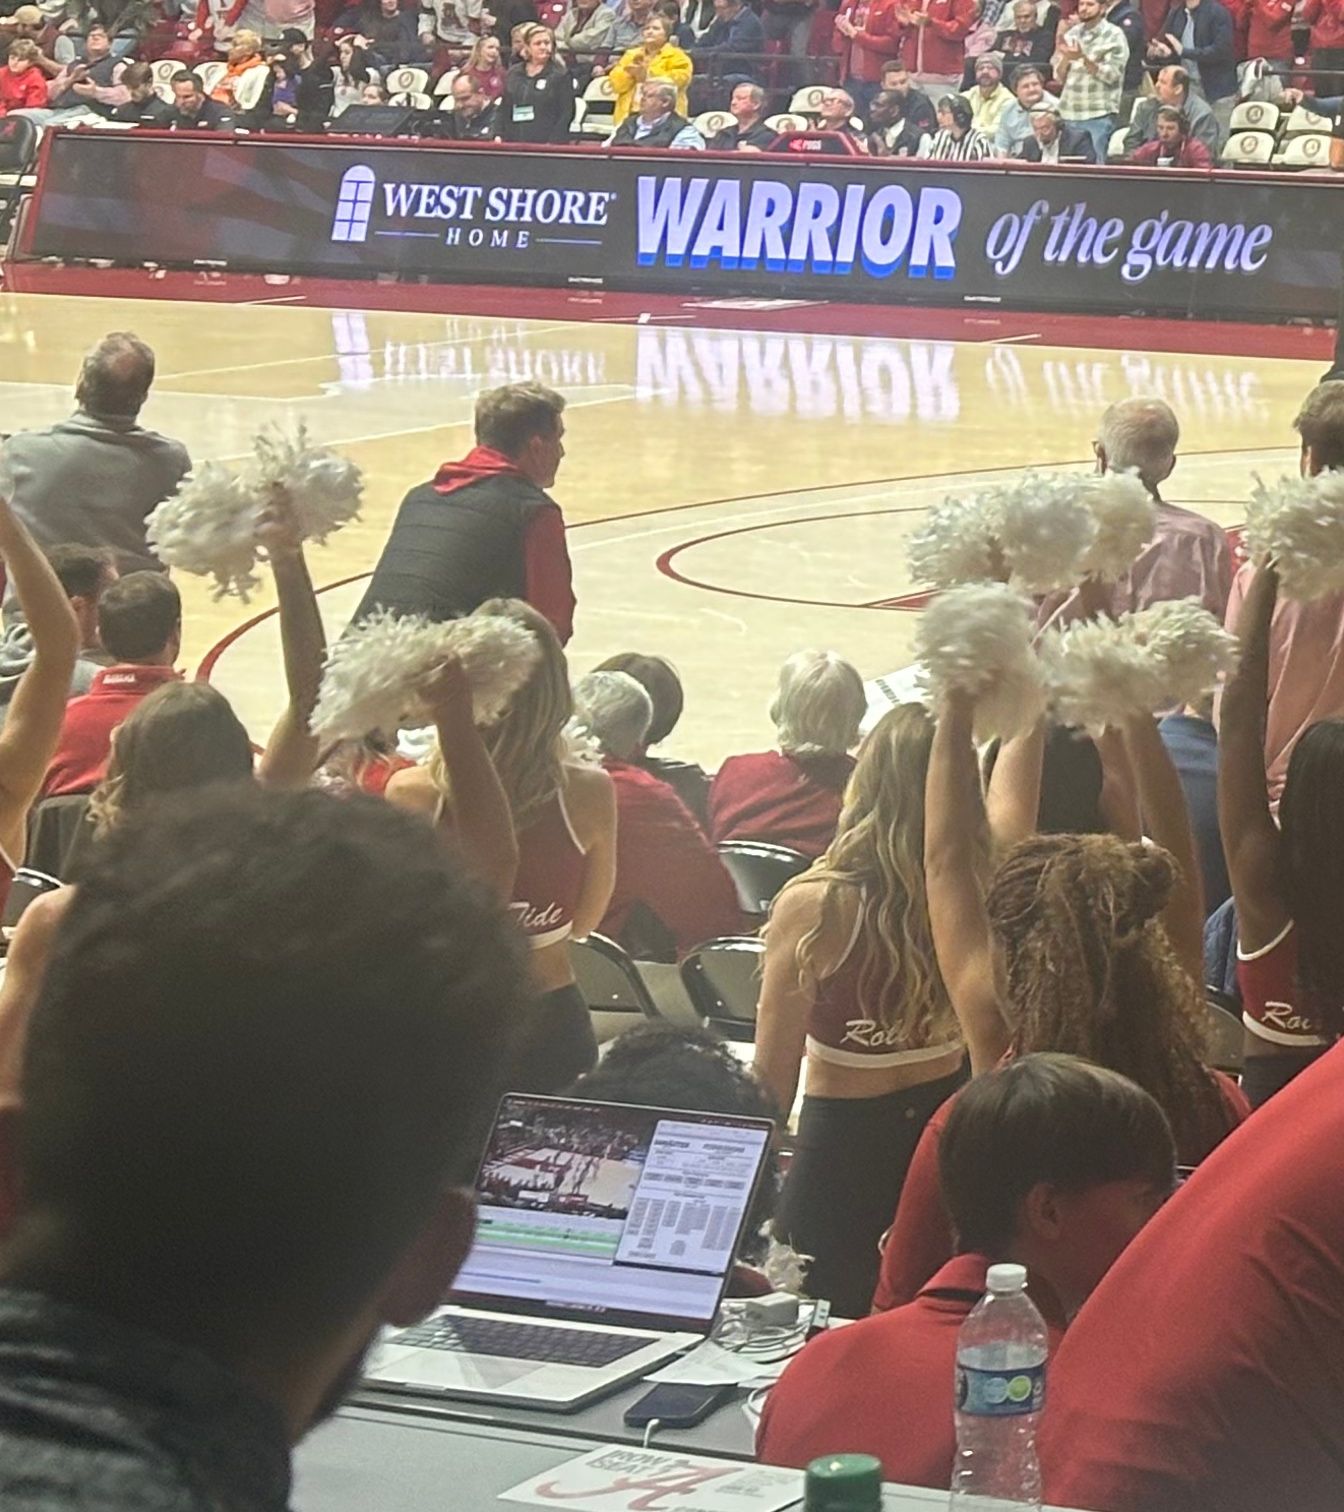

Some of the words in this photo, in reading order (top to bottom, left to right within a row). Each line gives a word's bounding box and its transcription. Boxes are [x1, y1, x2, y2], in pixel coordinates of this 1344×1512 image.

[382, 182, 483, 220] WEST
[484, 186, 612, 226] SHORE
[445, 226, 530, 250] HOME
[636, 175, 963, 281] WARRIOR
[985, 198, 1050, 277] of
[1042, 200, 1125, 265] the
[1120, 208, 1274, 283] game
[507, 901, 563, 928] Tide
